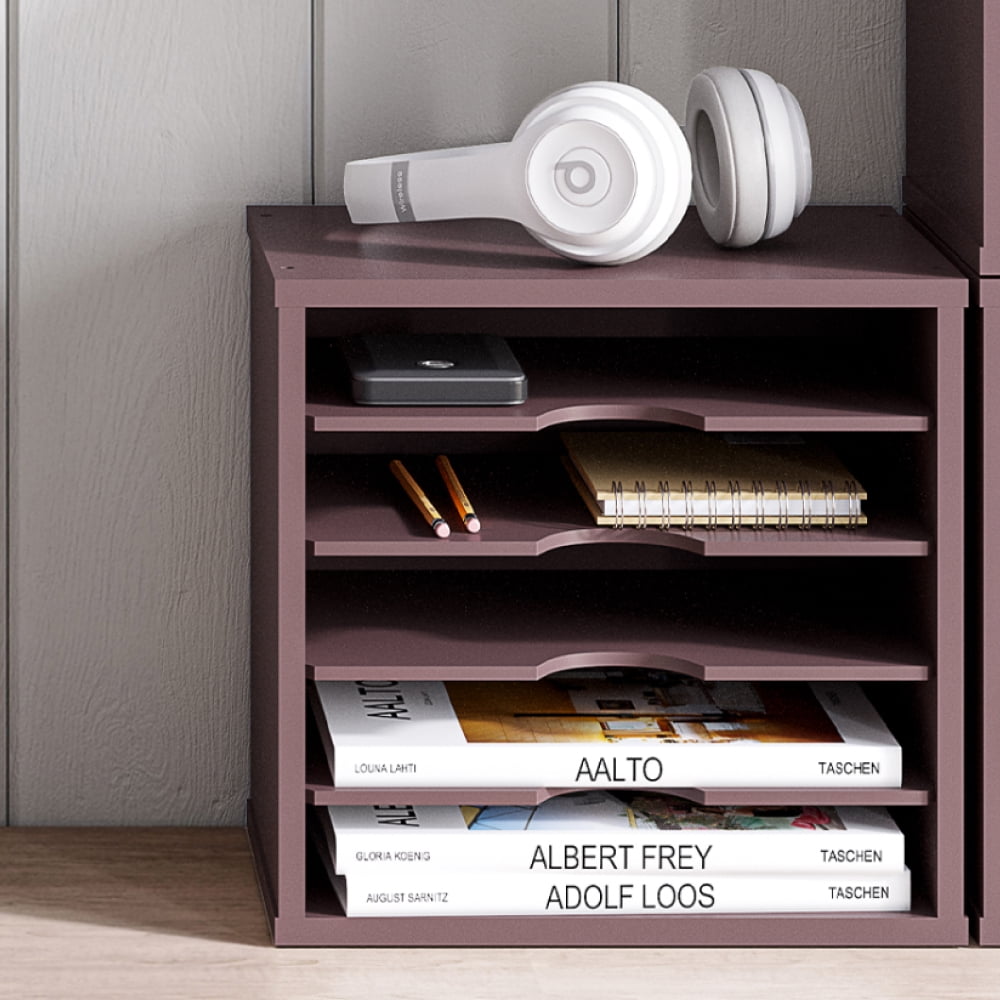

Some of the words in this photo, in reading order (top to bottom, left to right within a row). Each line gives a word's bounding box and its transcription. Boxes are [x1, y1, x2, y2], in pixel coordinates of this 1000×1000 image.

[396, 170, 408, 213] Wireless
[354, 763, 388, 774] LOUNA
[389, 763, 417, 774] LAHTI
[575, 756, 664, 782] AALTO
[818, 761, 880, 775] TASCHEN
[355, 851, 392, 861] GLORIA
[394, 851, 431, 861] KOENIG
[529, 844, 634, 870] ALBERT
[641, 844, 713, 870] FREY
[820, 849, 883, 863] TASCHEN
[366, 892, 405, 903] AUGUST
[407, 891, 449, 903] SARNITZ
[545, 884, 634, 910] ADOLF
[642, 883, 716, 909] LOOS
[828, 885, 890, 900] TASCHEN
